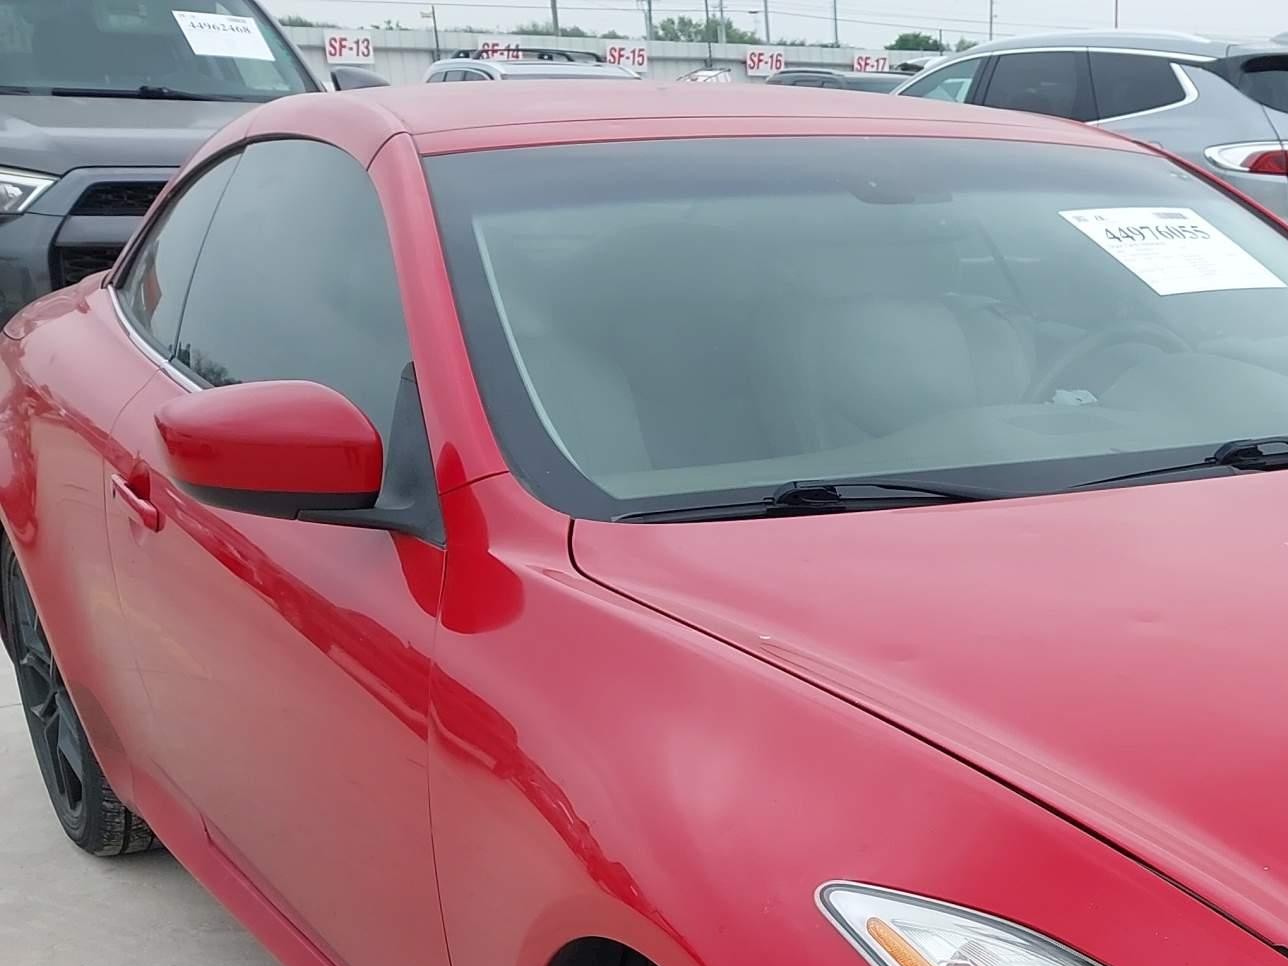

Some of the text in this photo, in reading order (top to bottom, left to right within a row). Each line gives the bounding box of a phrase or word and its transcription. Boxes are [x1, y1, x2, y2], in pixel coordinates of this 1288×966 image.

[327, 36, 371, 58] SF-13
[608, 46, 646, 66] SF-15
[747, 51, 783, 70] SF-16
[856, 56, 887, 72] SF-17
[1105, 224, 1210, 243] 44976055
